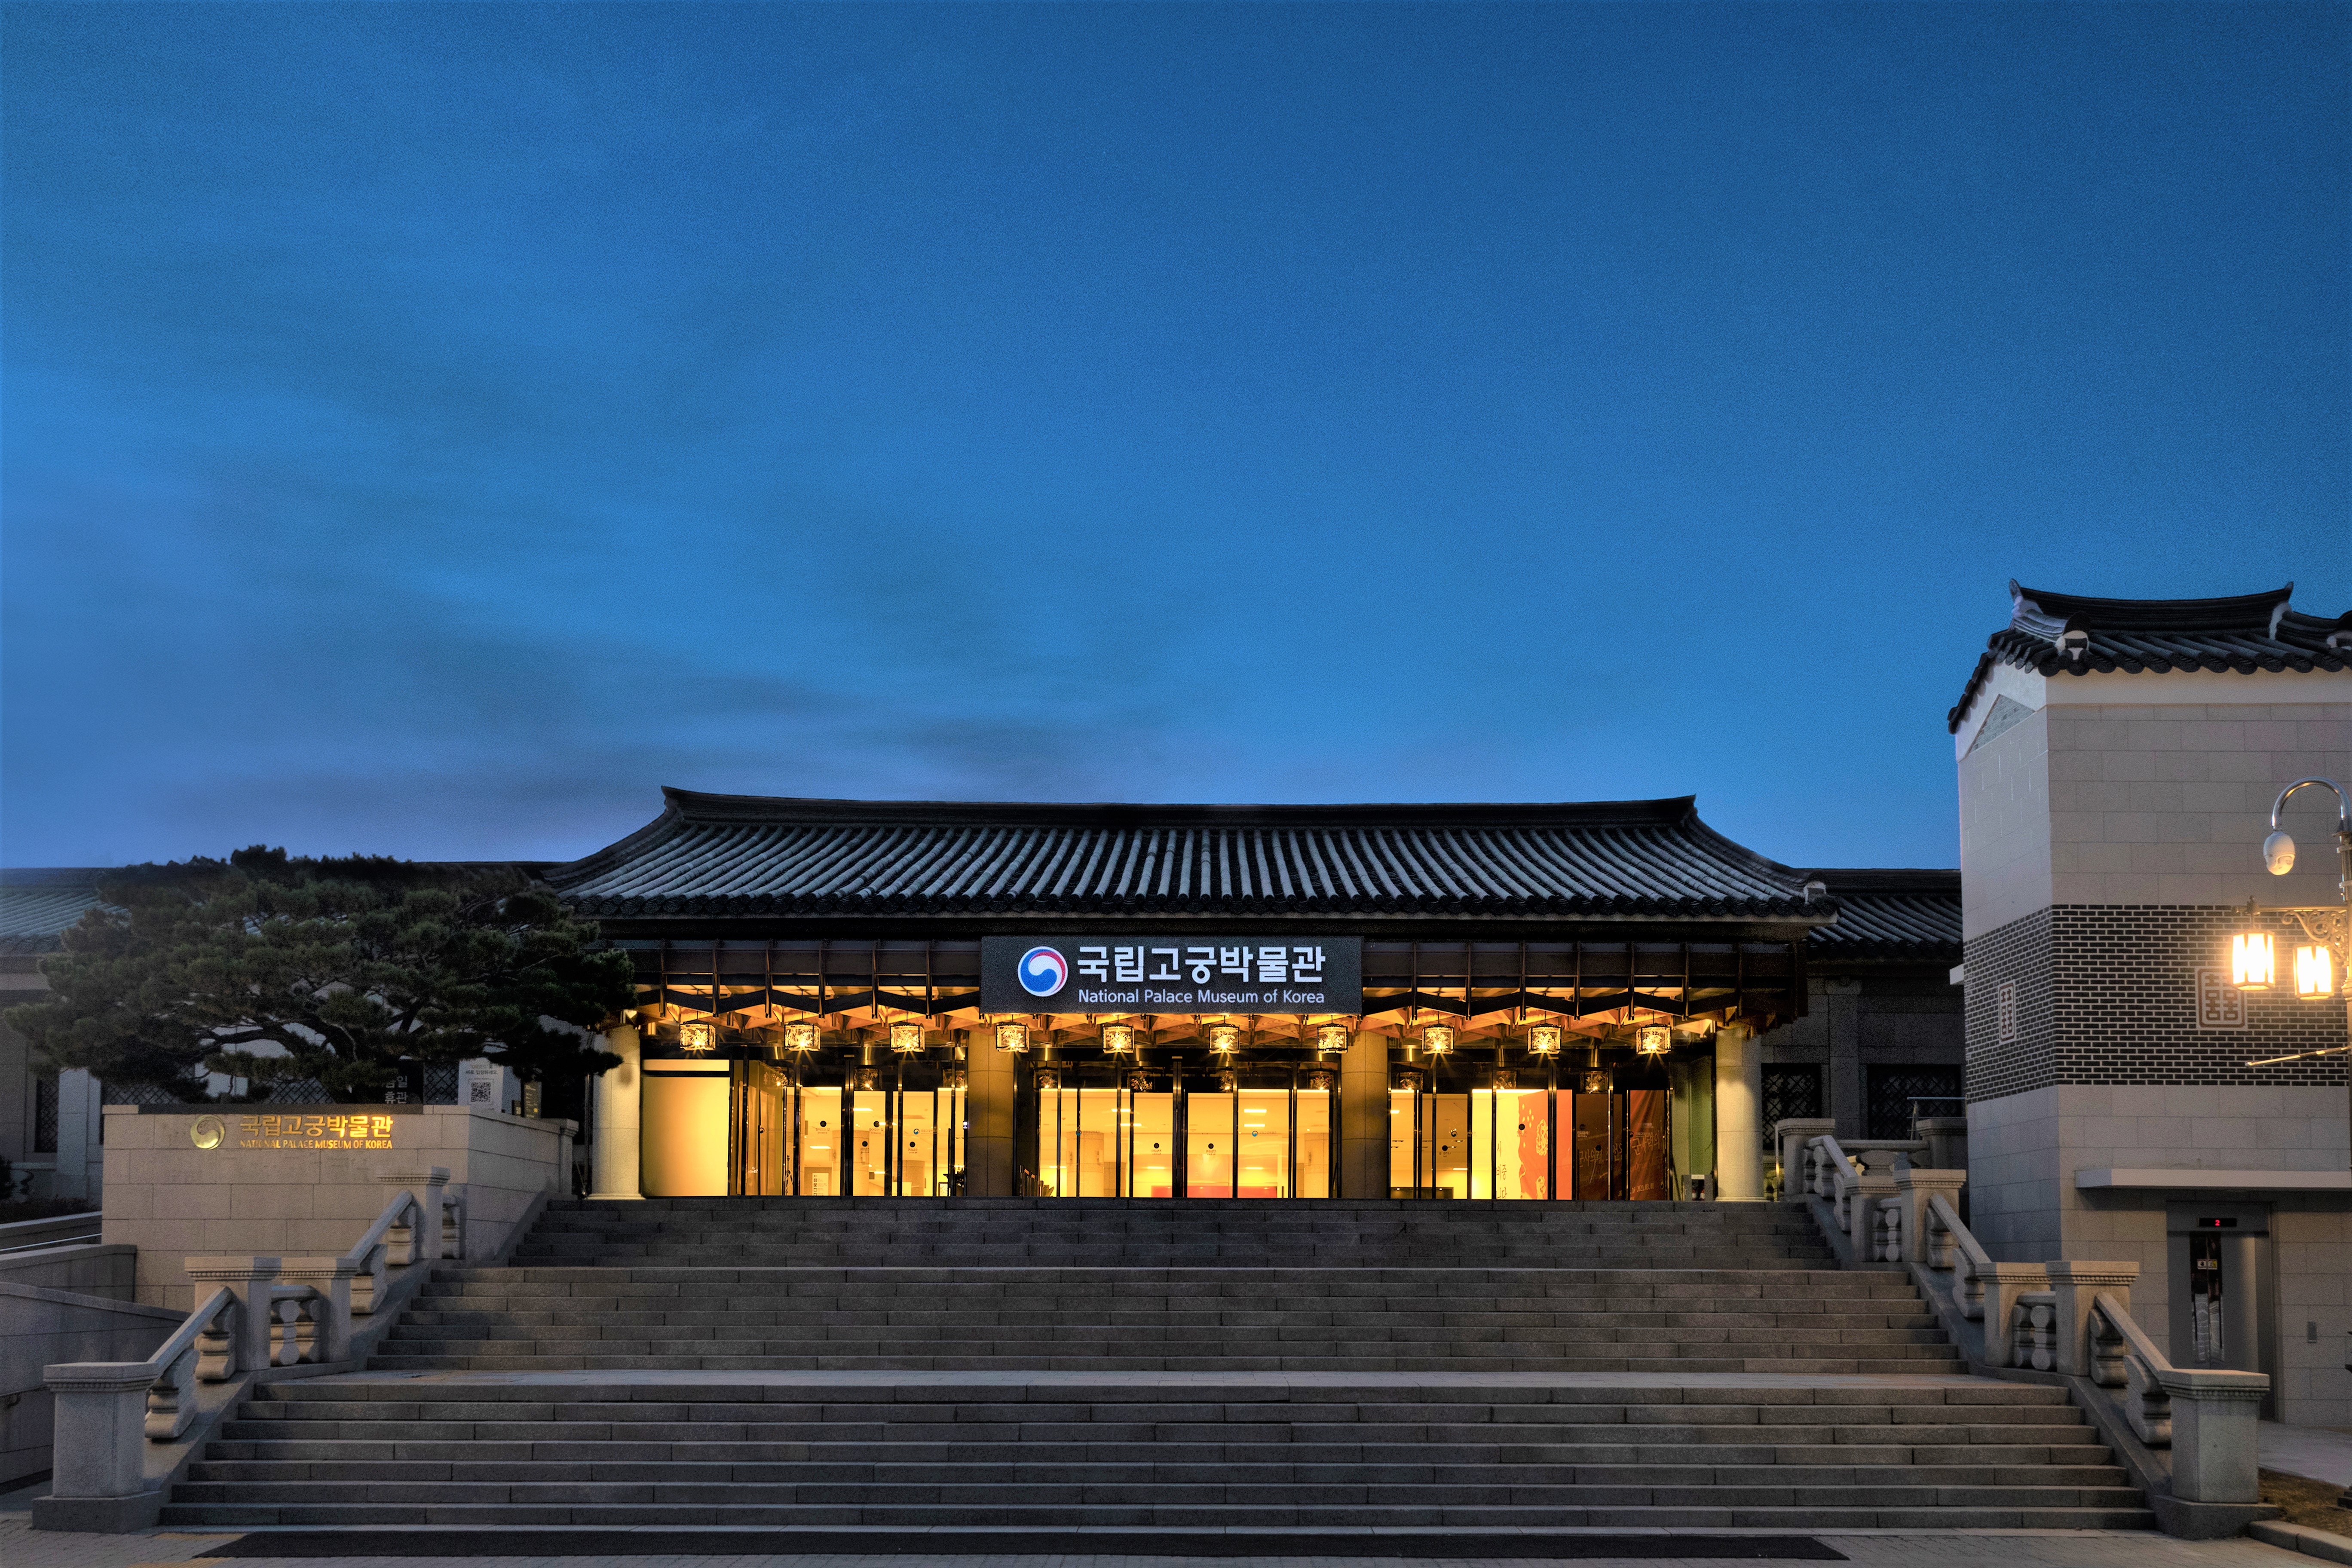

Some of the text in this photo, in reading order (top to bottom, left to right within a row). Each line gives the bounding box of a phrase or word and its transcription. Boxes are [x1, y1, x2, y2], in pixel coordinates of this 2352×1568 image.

[1077, 946, 1326, 984] 국립고궁박물관
[1079, 989, 1324, 1003] National Palace Museum of Korea
[240, 1115, 394, 1138] 국립고궁박물관
[240, 1139, 392, 1149] NATIONAL PALACE MUSEUM OF KOREA
